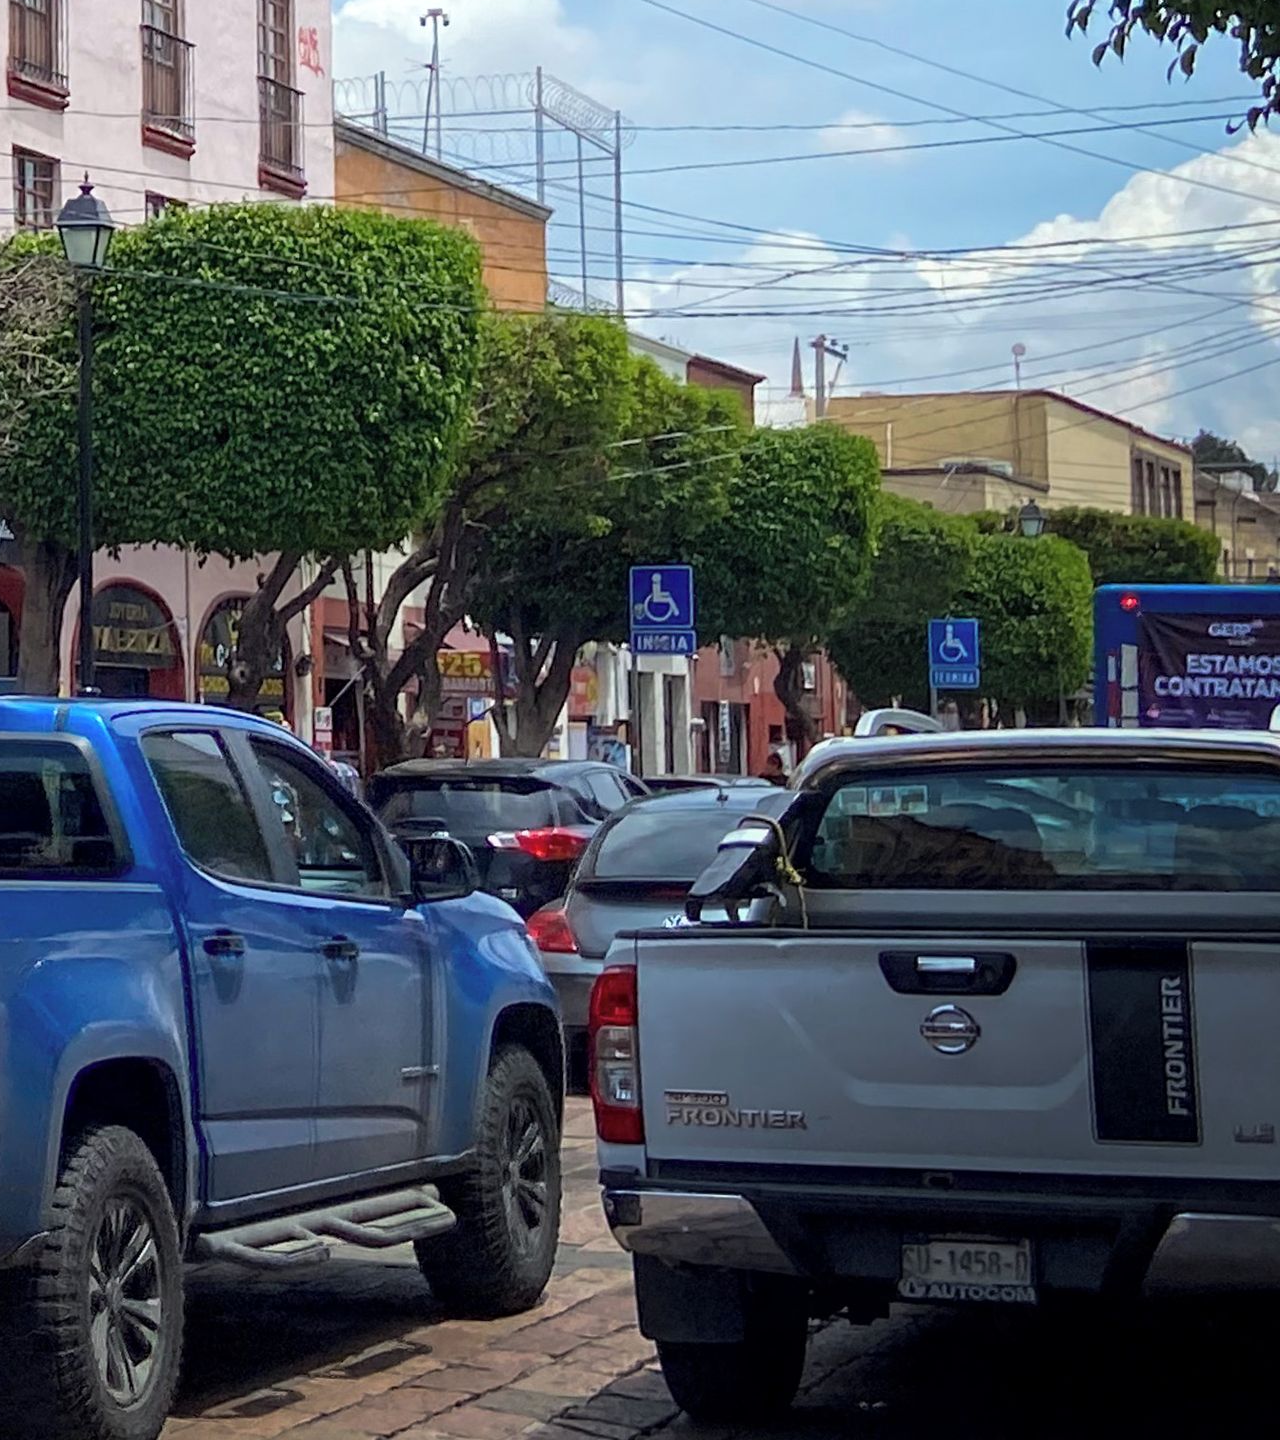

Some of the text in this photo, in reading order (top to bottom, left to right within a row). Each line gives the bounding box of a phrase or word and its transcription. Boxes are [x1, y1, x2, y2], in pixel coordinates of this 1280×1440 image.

[637, 635, 689, 651] INICIA
[1160, 976, 1188, 1116] FRONTIER
[667, 1108, 807, 1131] FRONTIER
